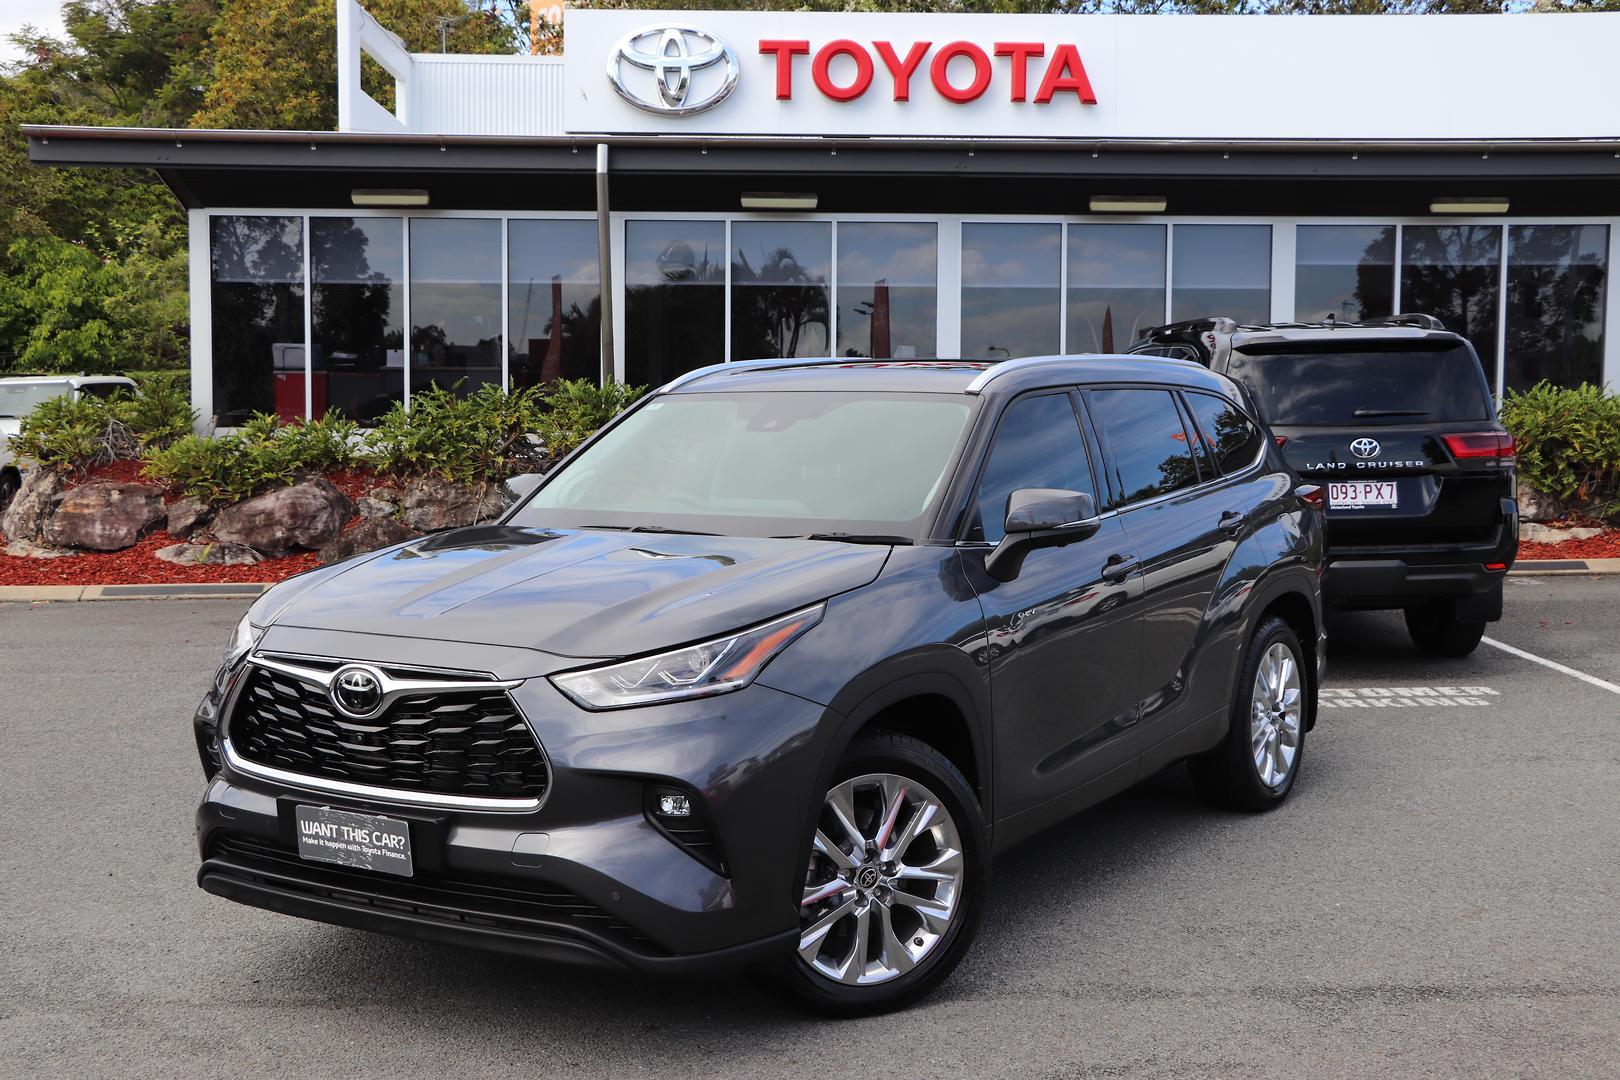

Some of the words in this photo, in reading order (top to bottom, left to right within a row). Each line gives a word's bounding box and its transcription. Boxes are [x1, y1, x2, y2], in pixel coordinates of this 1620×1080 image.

[759, 39, 1098, 105] TOYOTA
[1306, 462, 1347, 470] LAND
[1356, 460, 1424, 469] CRUISER
[1318, 686, 1500, 698] STOMER
[1318, 697, 1491, 708] RKING
[301, 820, 338, 838] WANT
[340, 825, 370, 844] THIS
[372, 831, 405, 850] CAR?
[302, 836, 319, 845] Make
[319, 838, 325, 846] it
[325, 839, 347, 849] happen
[347, 842, 361, 851] with
[361, 845, 381, 856] Toyota
[382, 848, 407, 860] Finance.
